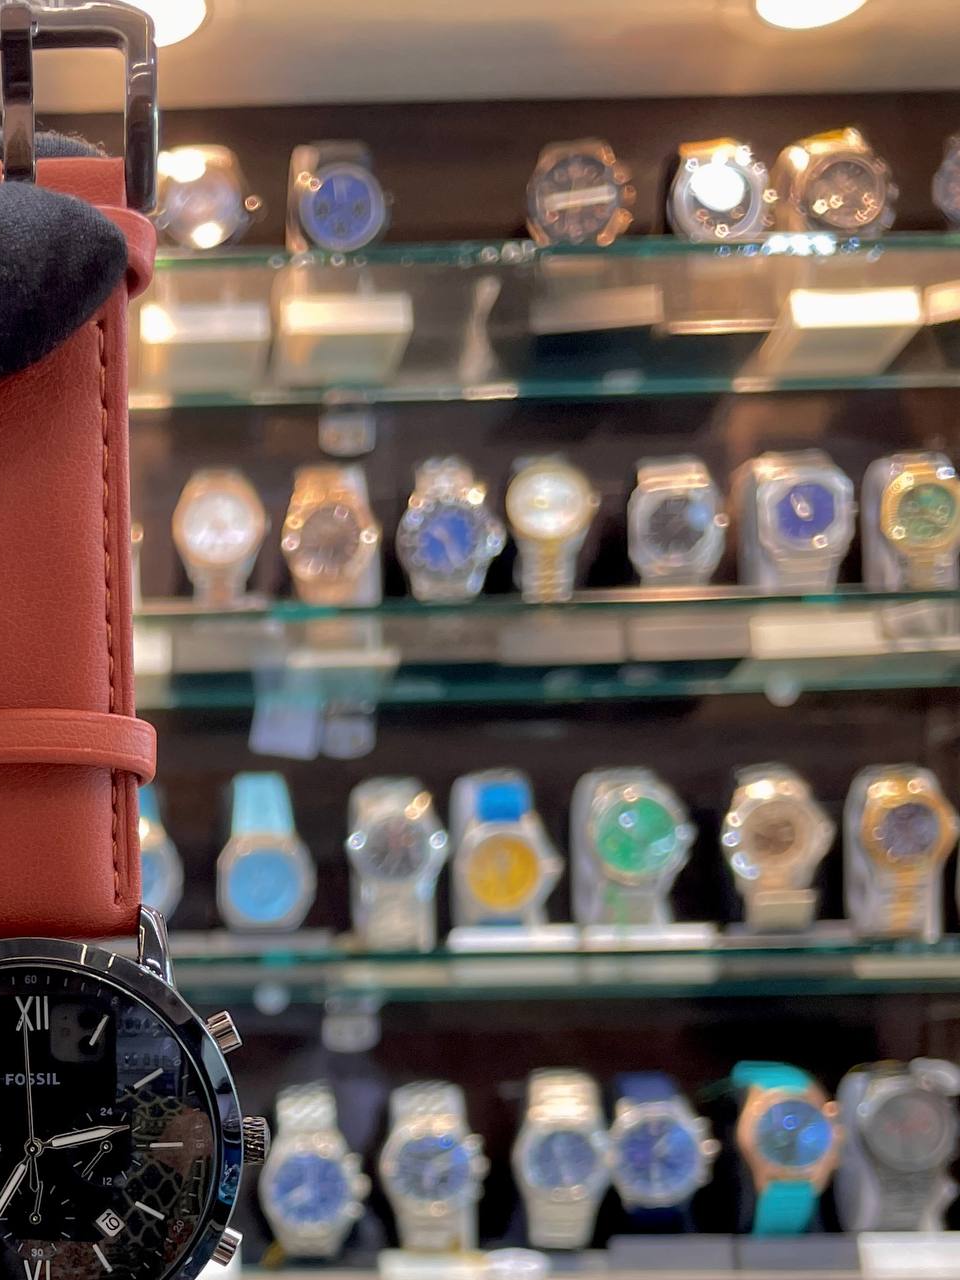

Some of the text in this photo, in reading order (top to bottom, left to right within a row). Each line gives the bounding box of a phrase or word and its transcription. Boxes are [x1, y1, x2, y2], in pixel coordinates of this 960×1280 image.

[24, 975, 37, 984] 60
[15, 995, 49, 1032] XII
[5, 1072, 61, 1086] FOSSIL
[100, 1108, 113, 1116] 24
[102, 1177, 113, 1186] 12
[101, 1212, 120, 1231] 19
[173, 1220, 185, 1233] 20
[31, 1248, 44, 1257] 30
